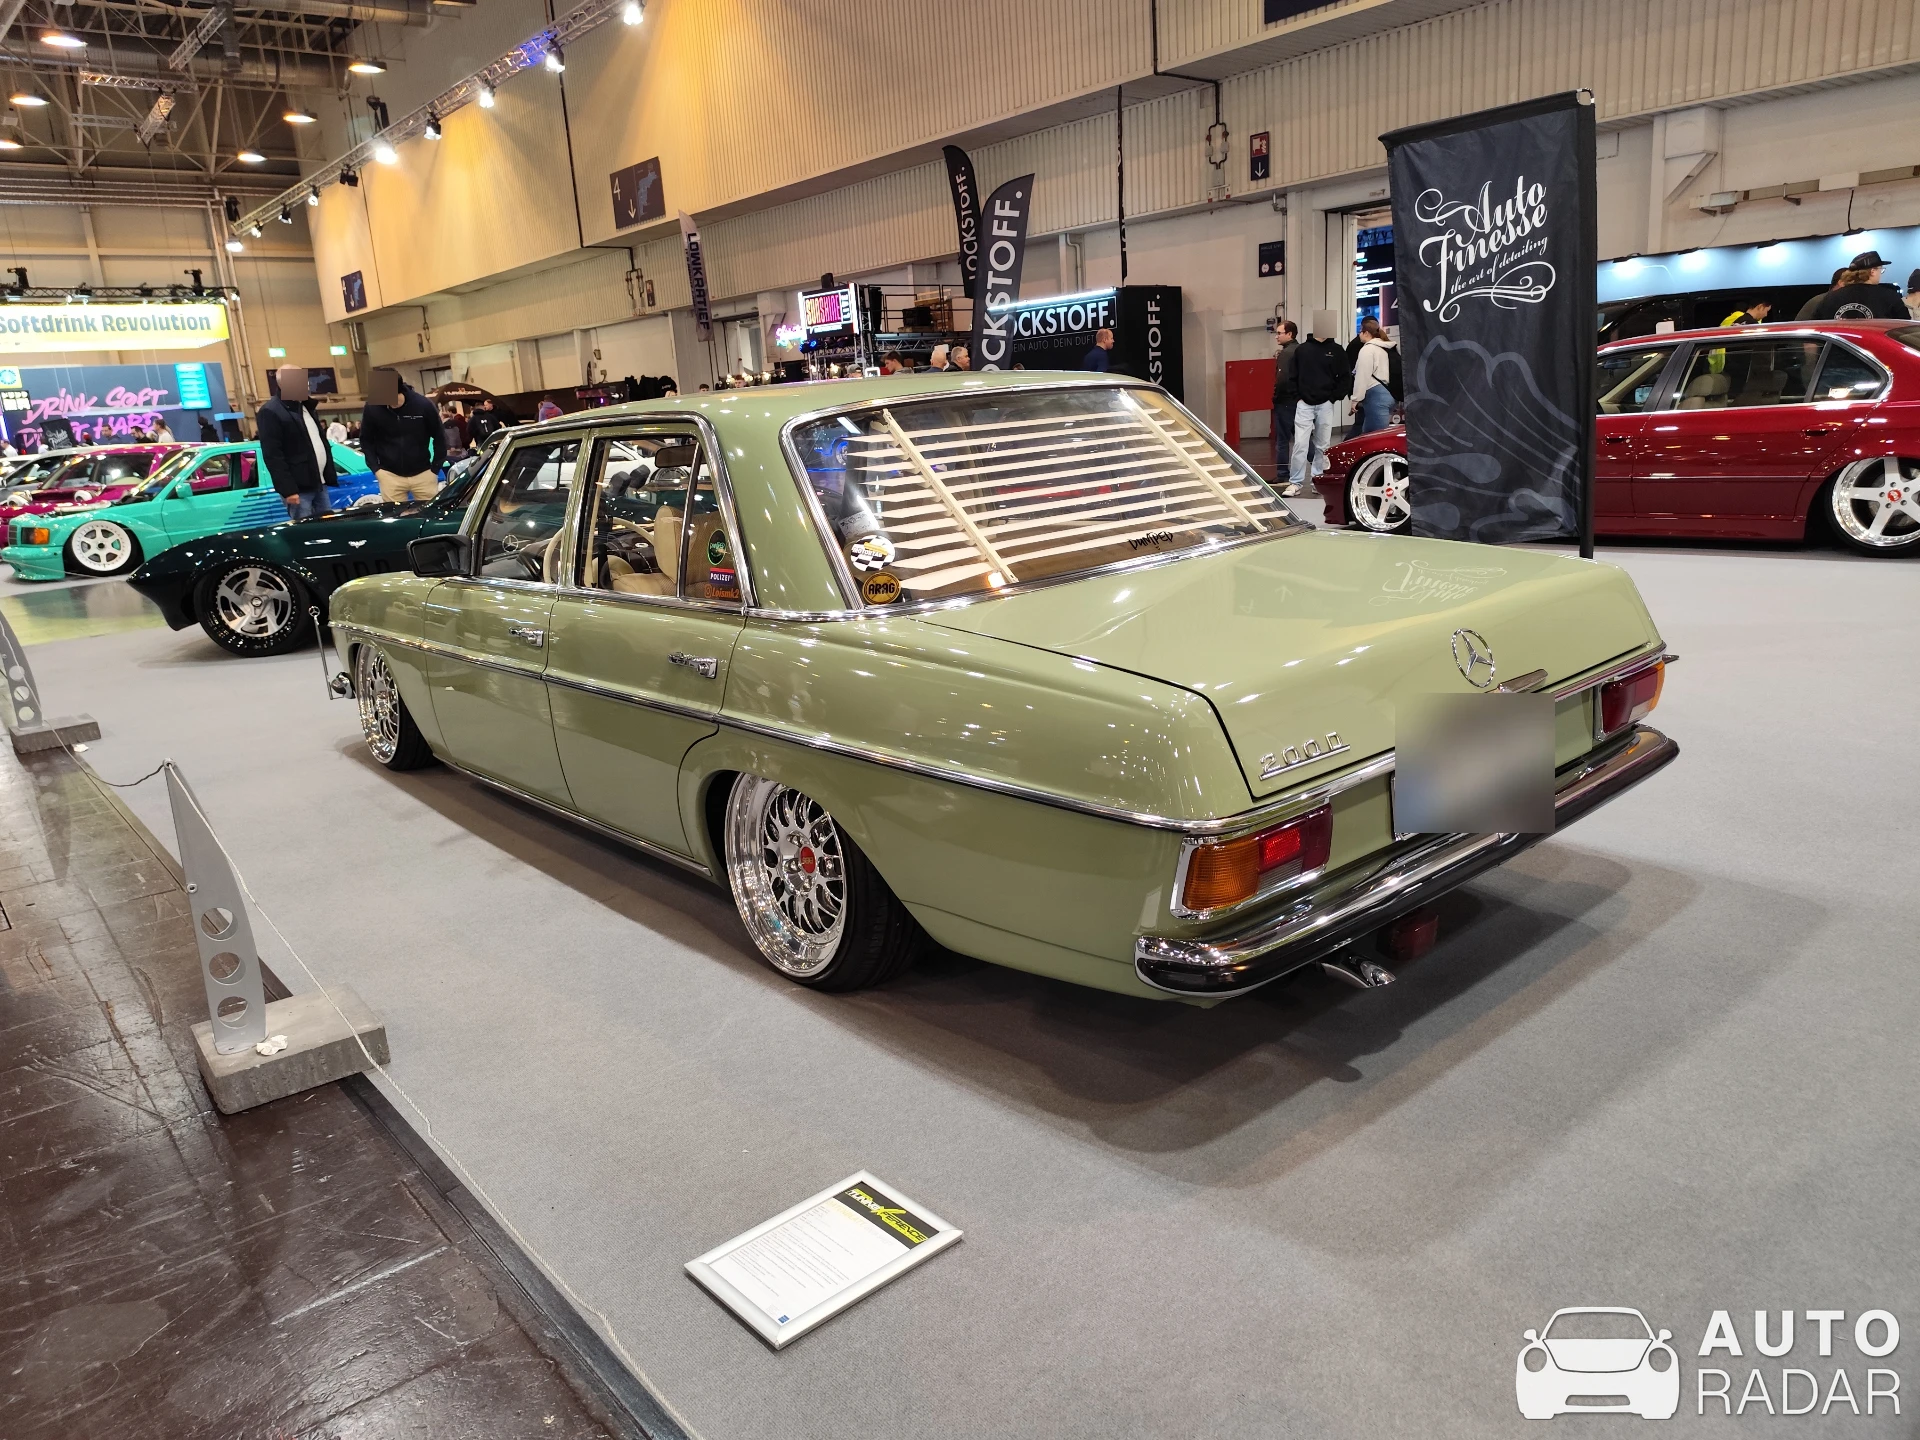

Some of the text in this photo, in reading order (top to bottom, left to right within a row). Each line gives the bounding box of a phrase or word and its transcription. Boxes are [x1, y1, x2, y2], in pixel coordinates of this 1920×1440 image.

[613, 177, 621, 201] 4
[1432, 175, 1547, 245] Auto
[1419, 204, 1548, 312] Finesse
[1450, 236, 1548, 295] the art of detailing
[981, 190, 1023, 371] CKSTOFF.
[0, 314, 212, 334] Softdrink Revolution
[1013, 301, 1115, 337] CKSTOFF.
[1013, 343, 1026, 353] EIN
[1028, 340, 1049, 350] AUTO
[1053, 337, 1073, 348] DEIN
[21, 387, 98, 425] DRINK
[105, 386, 169, 408] SOFT
[868, 582, 896, 595] ARAG
[1260, 731, 1344, 773] 200 D
